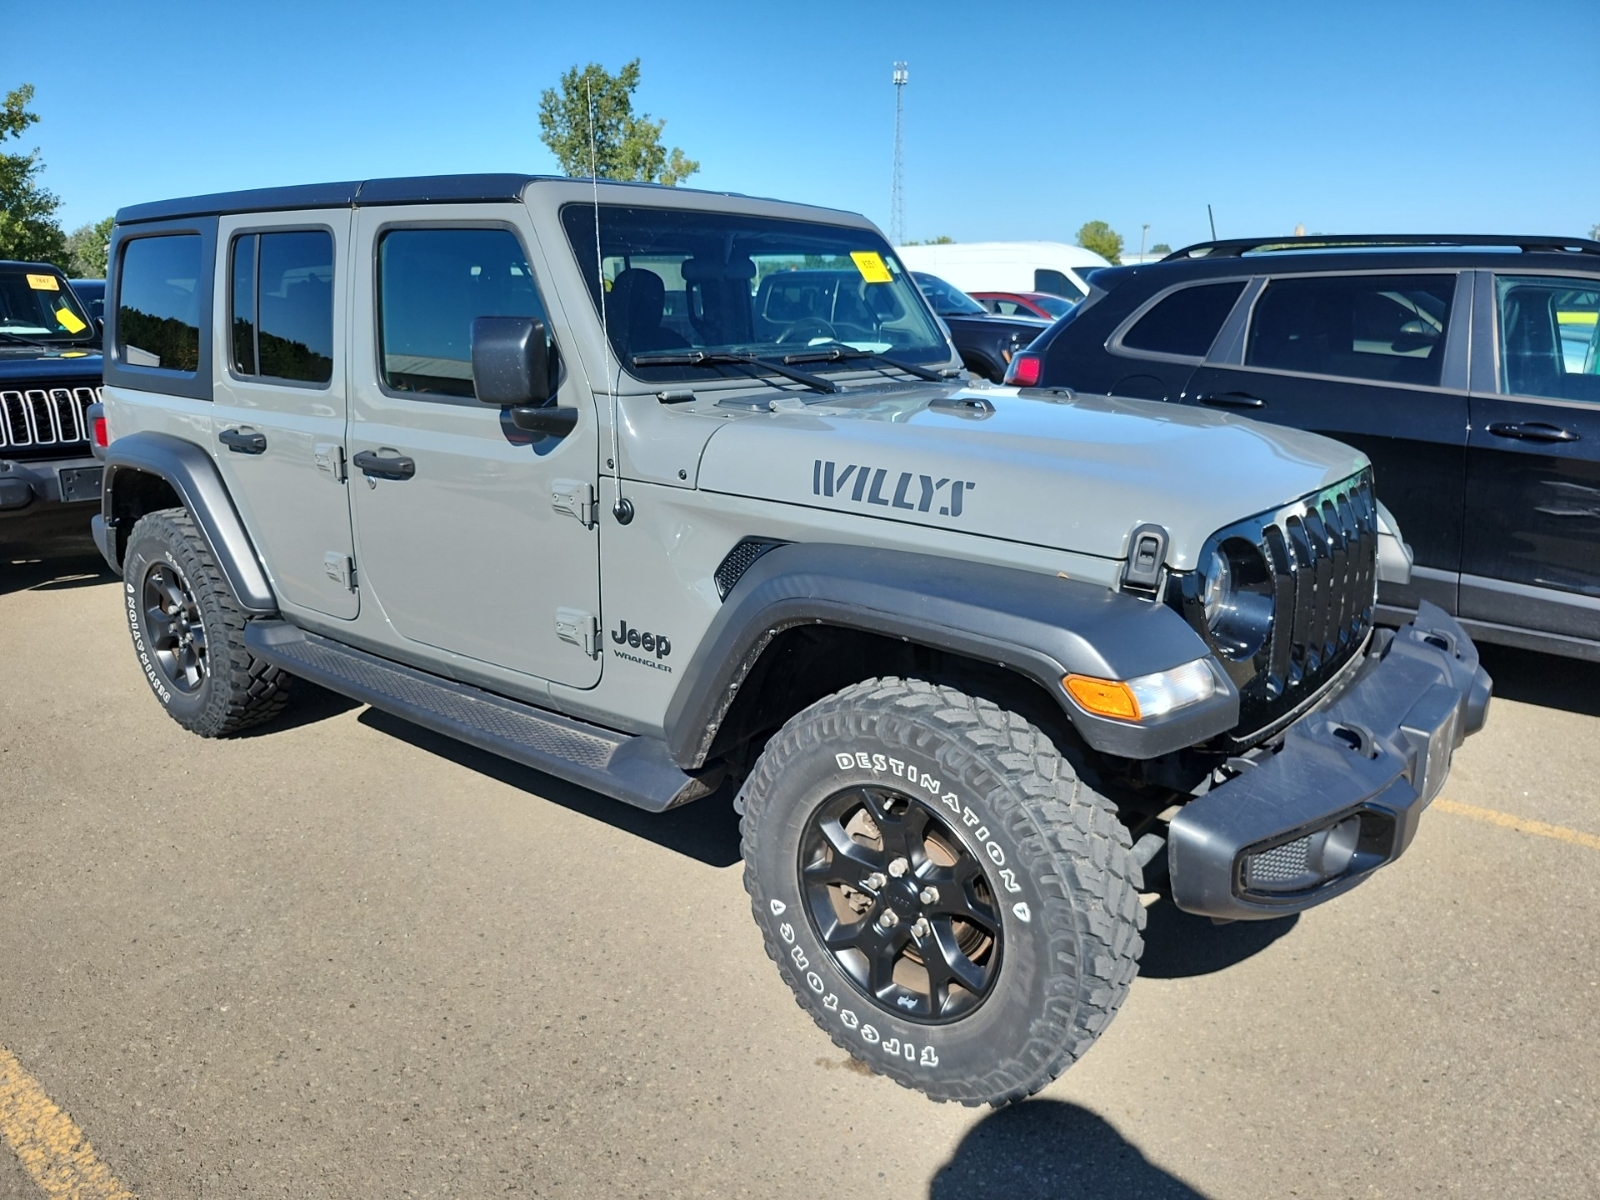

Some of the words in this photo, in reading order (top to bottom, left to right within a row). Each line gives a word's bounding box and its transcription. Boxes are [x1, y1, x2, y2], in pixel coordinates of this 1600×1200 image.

[813, 459, 976, 517] WILLYS
[127, 595, 171, 704] DESTINATION
[611, 619, 672, 660] Jeep
[613, 649, 672, 673] WRANGLER
[835, 752, 1021, 893] DESTINATION
